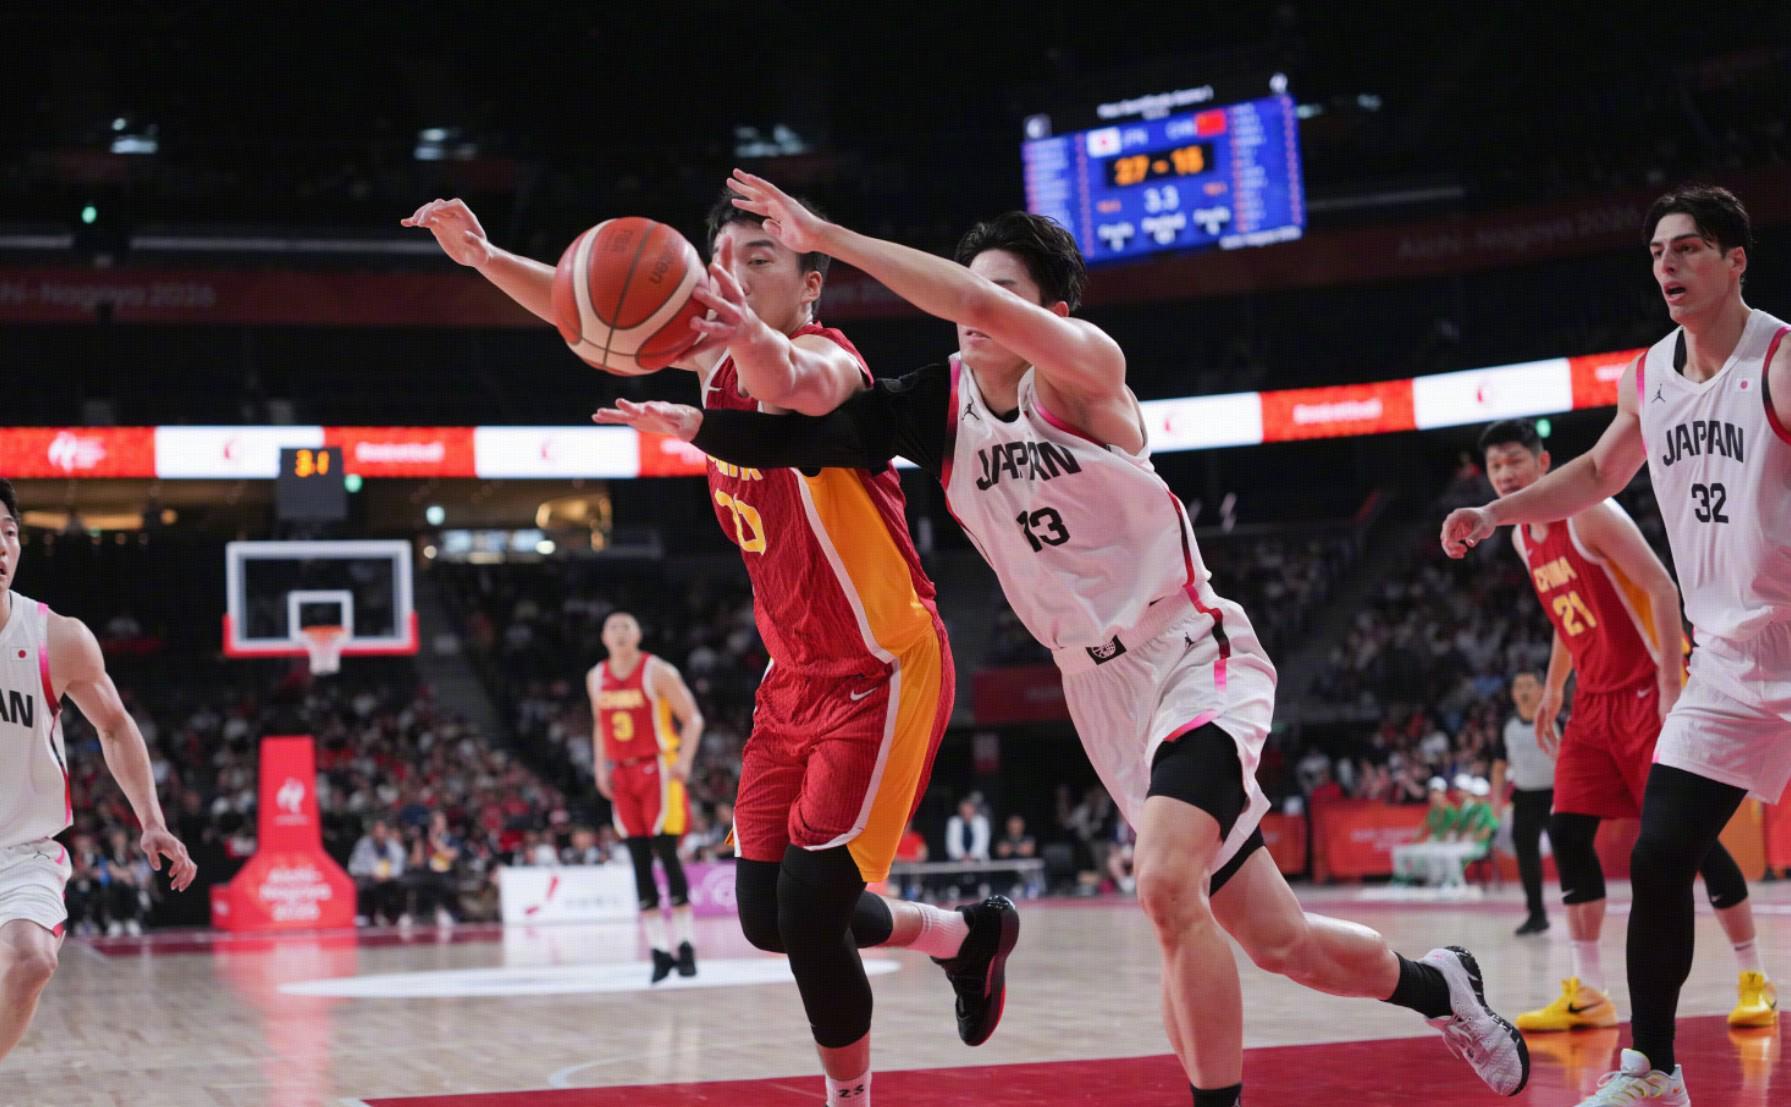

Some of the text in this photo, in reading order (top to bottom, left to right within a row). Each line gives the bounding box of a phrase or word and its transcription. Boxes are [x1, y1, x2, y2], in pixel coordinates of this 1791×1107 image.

[976, 440, 1083, 491] JAPAN
[1663, 420, 1744, 467] JAPAN
[1691, 483, 1729, 524] 32
[1016, 506, 1071, 553] 13
[1553, 590, 1597, 637] 21
[611, 711, 634, 742] 3
